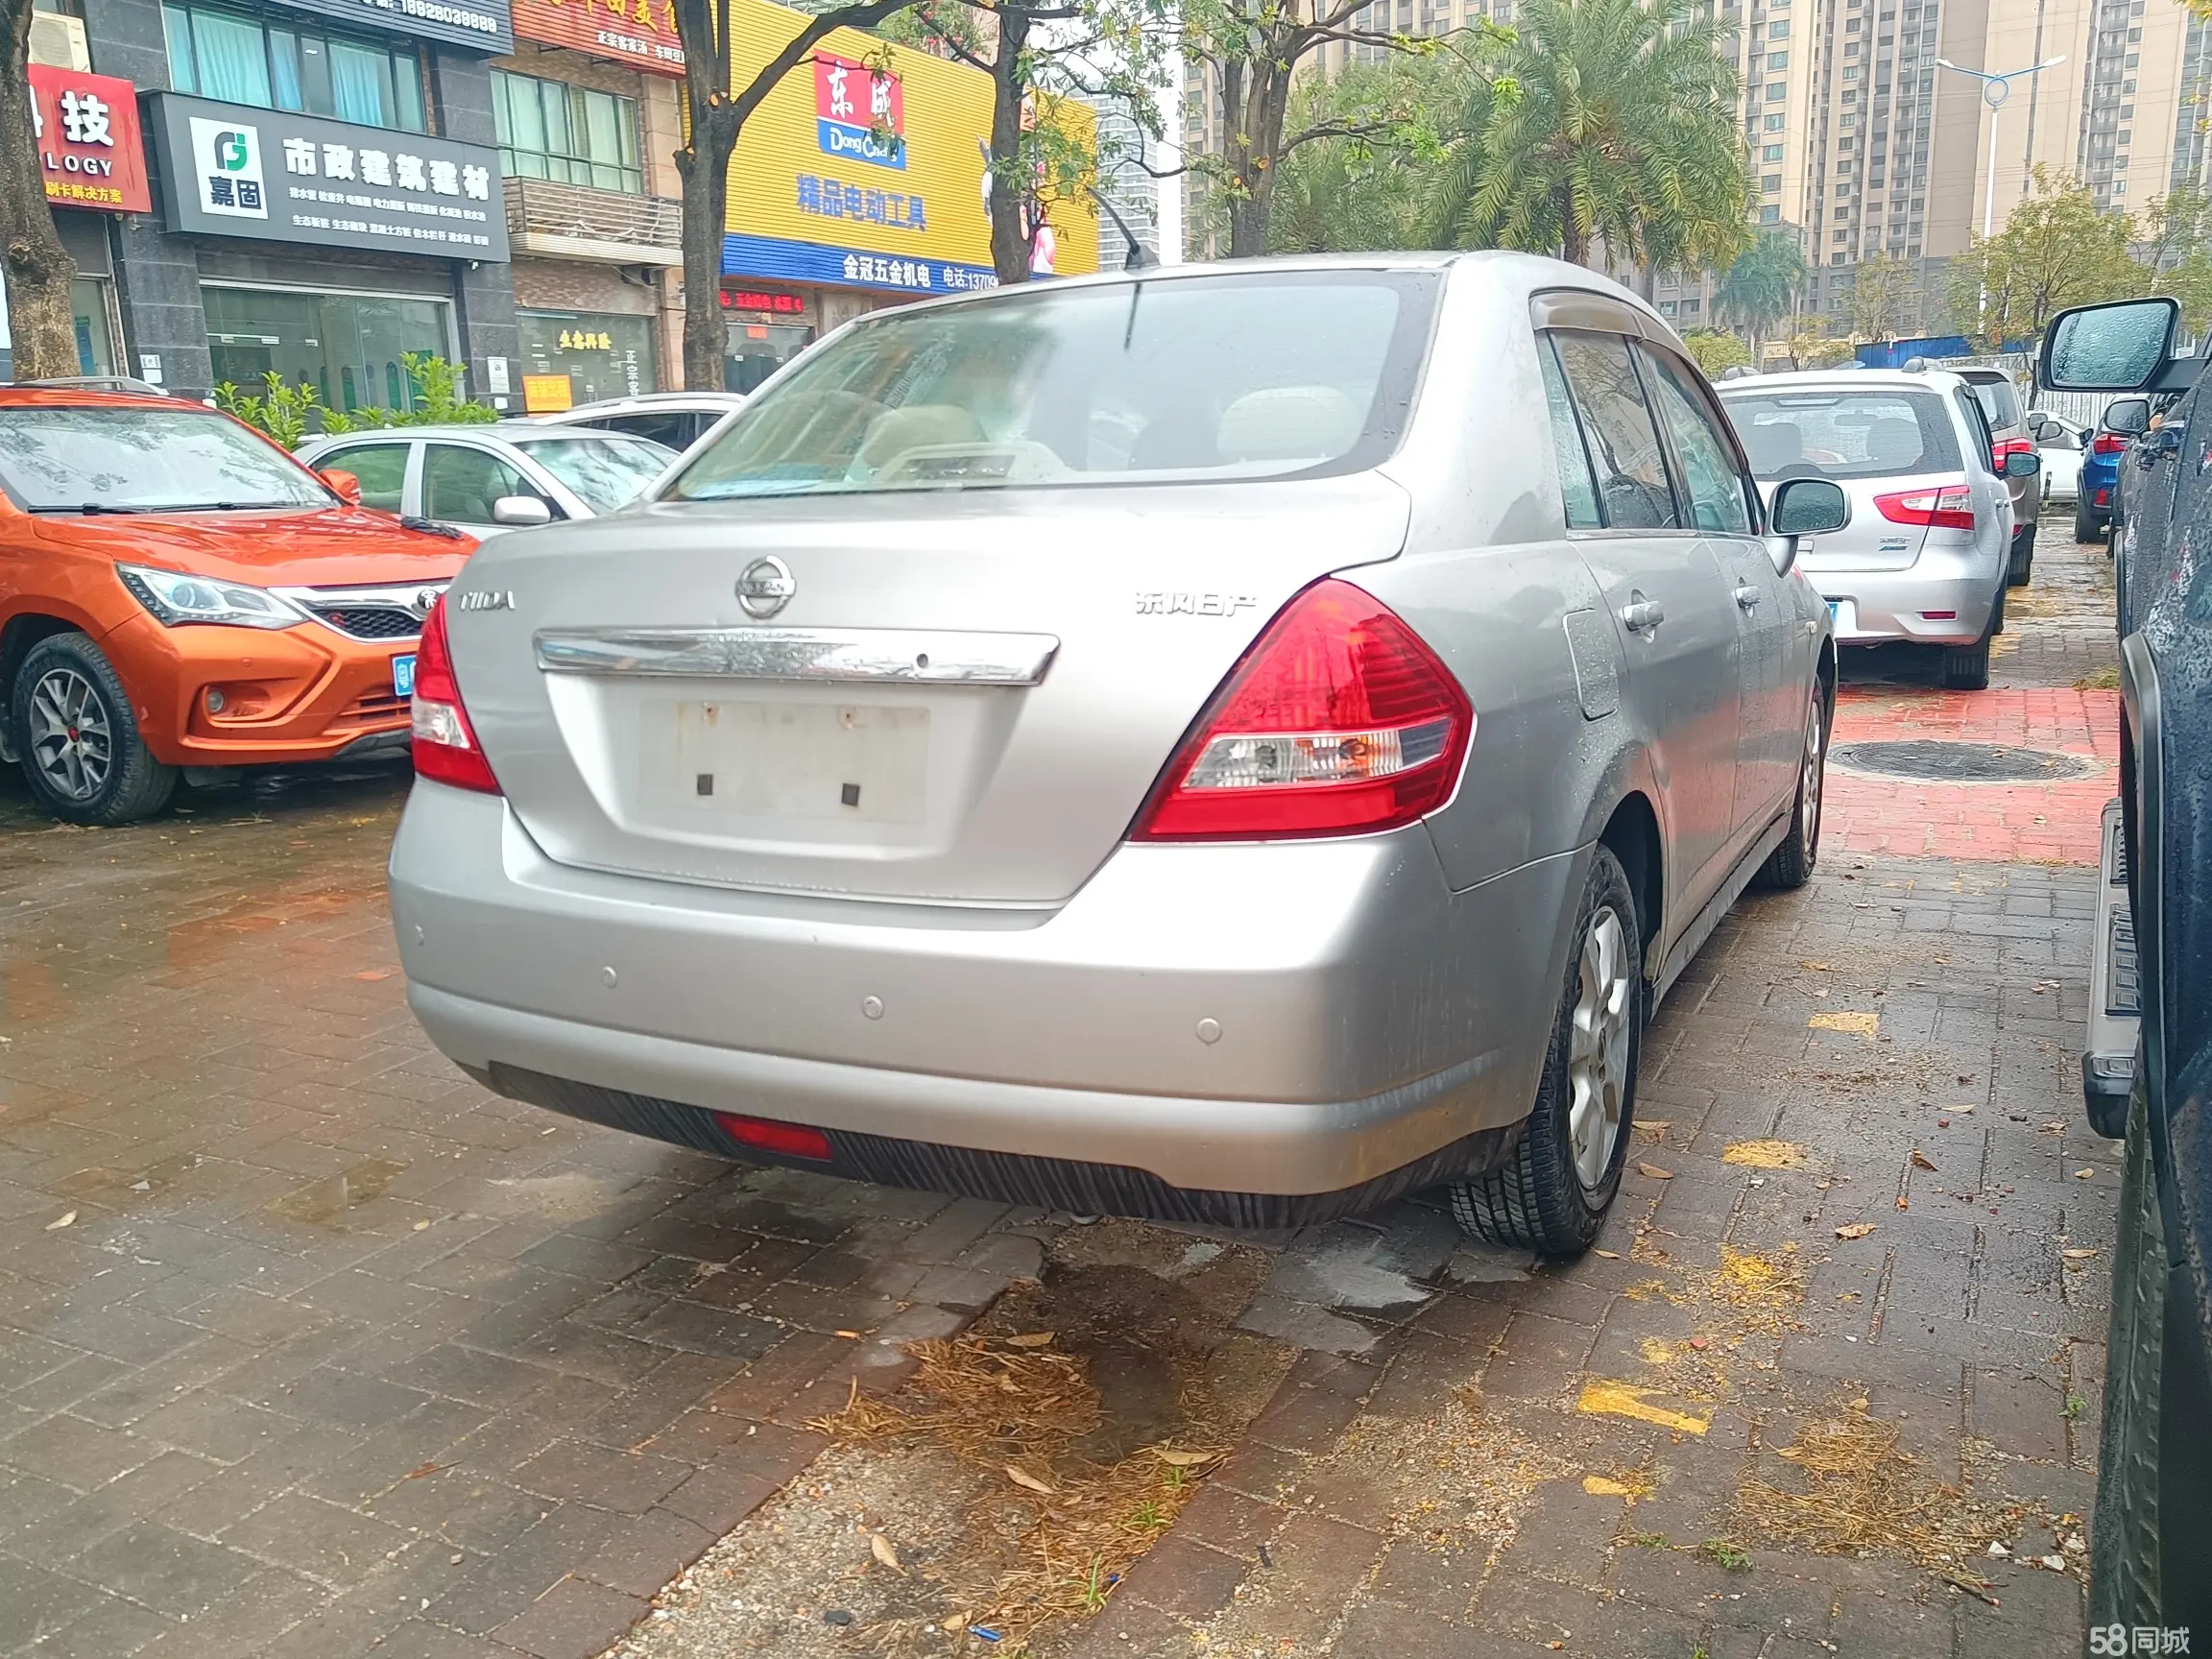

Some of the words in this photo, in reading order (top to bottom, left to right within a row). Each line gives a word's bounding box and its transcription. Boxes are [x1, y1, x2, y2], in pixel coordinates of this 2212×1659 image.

[654, 45, 685, 63] 车田豆
[29, 84, 114, 147] 技
[39, 152, 112, 177] LOGY
[282, 137, 490, 202] 市政建筑建材
[45, 180, 123, 204] 刷卡解决方案
[208, 176, 262, 209] 嘉固
[798, 173, 927, 232] 精品电动工具
[843, 253, 930, 287] 金冠五金机电
[1136, 592, 1257, 616] 东风日产
